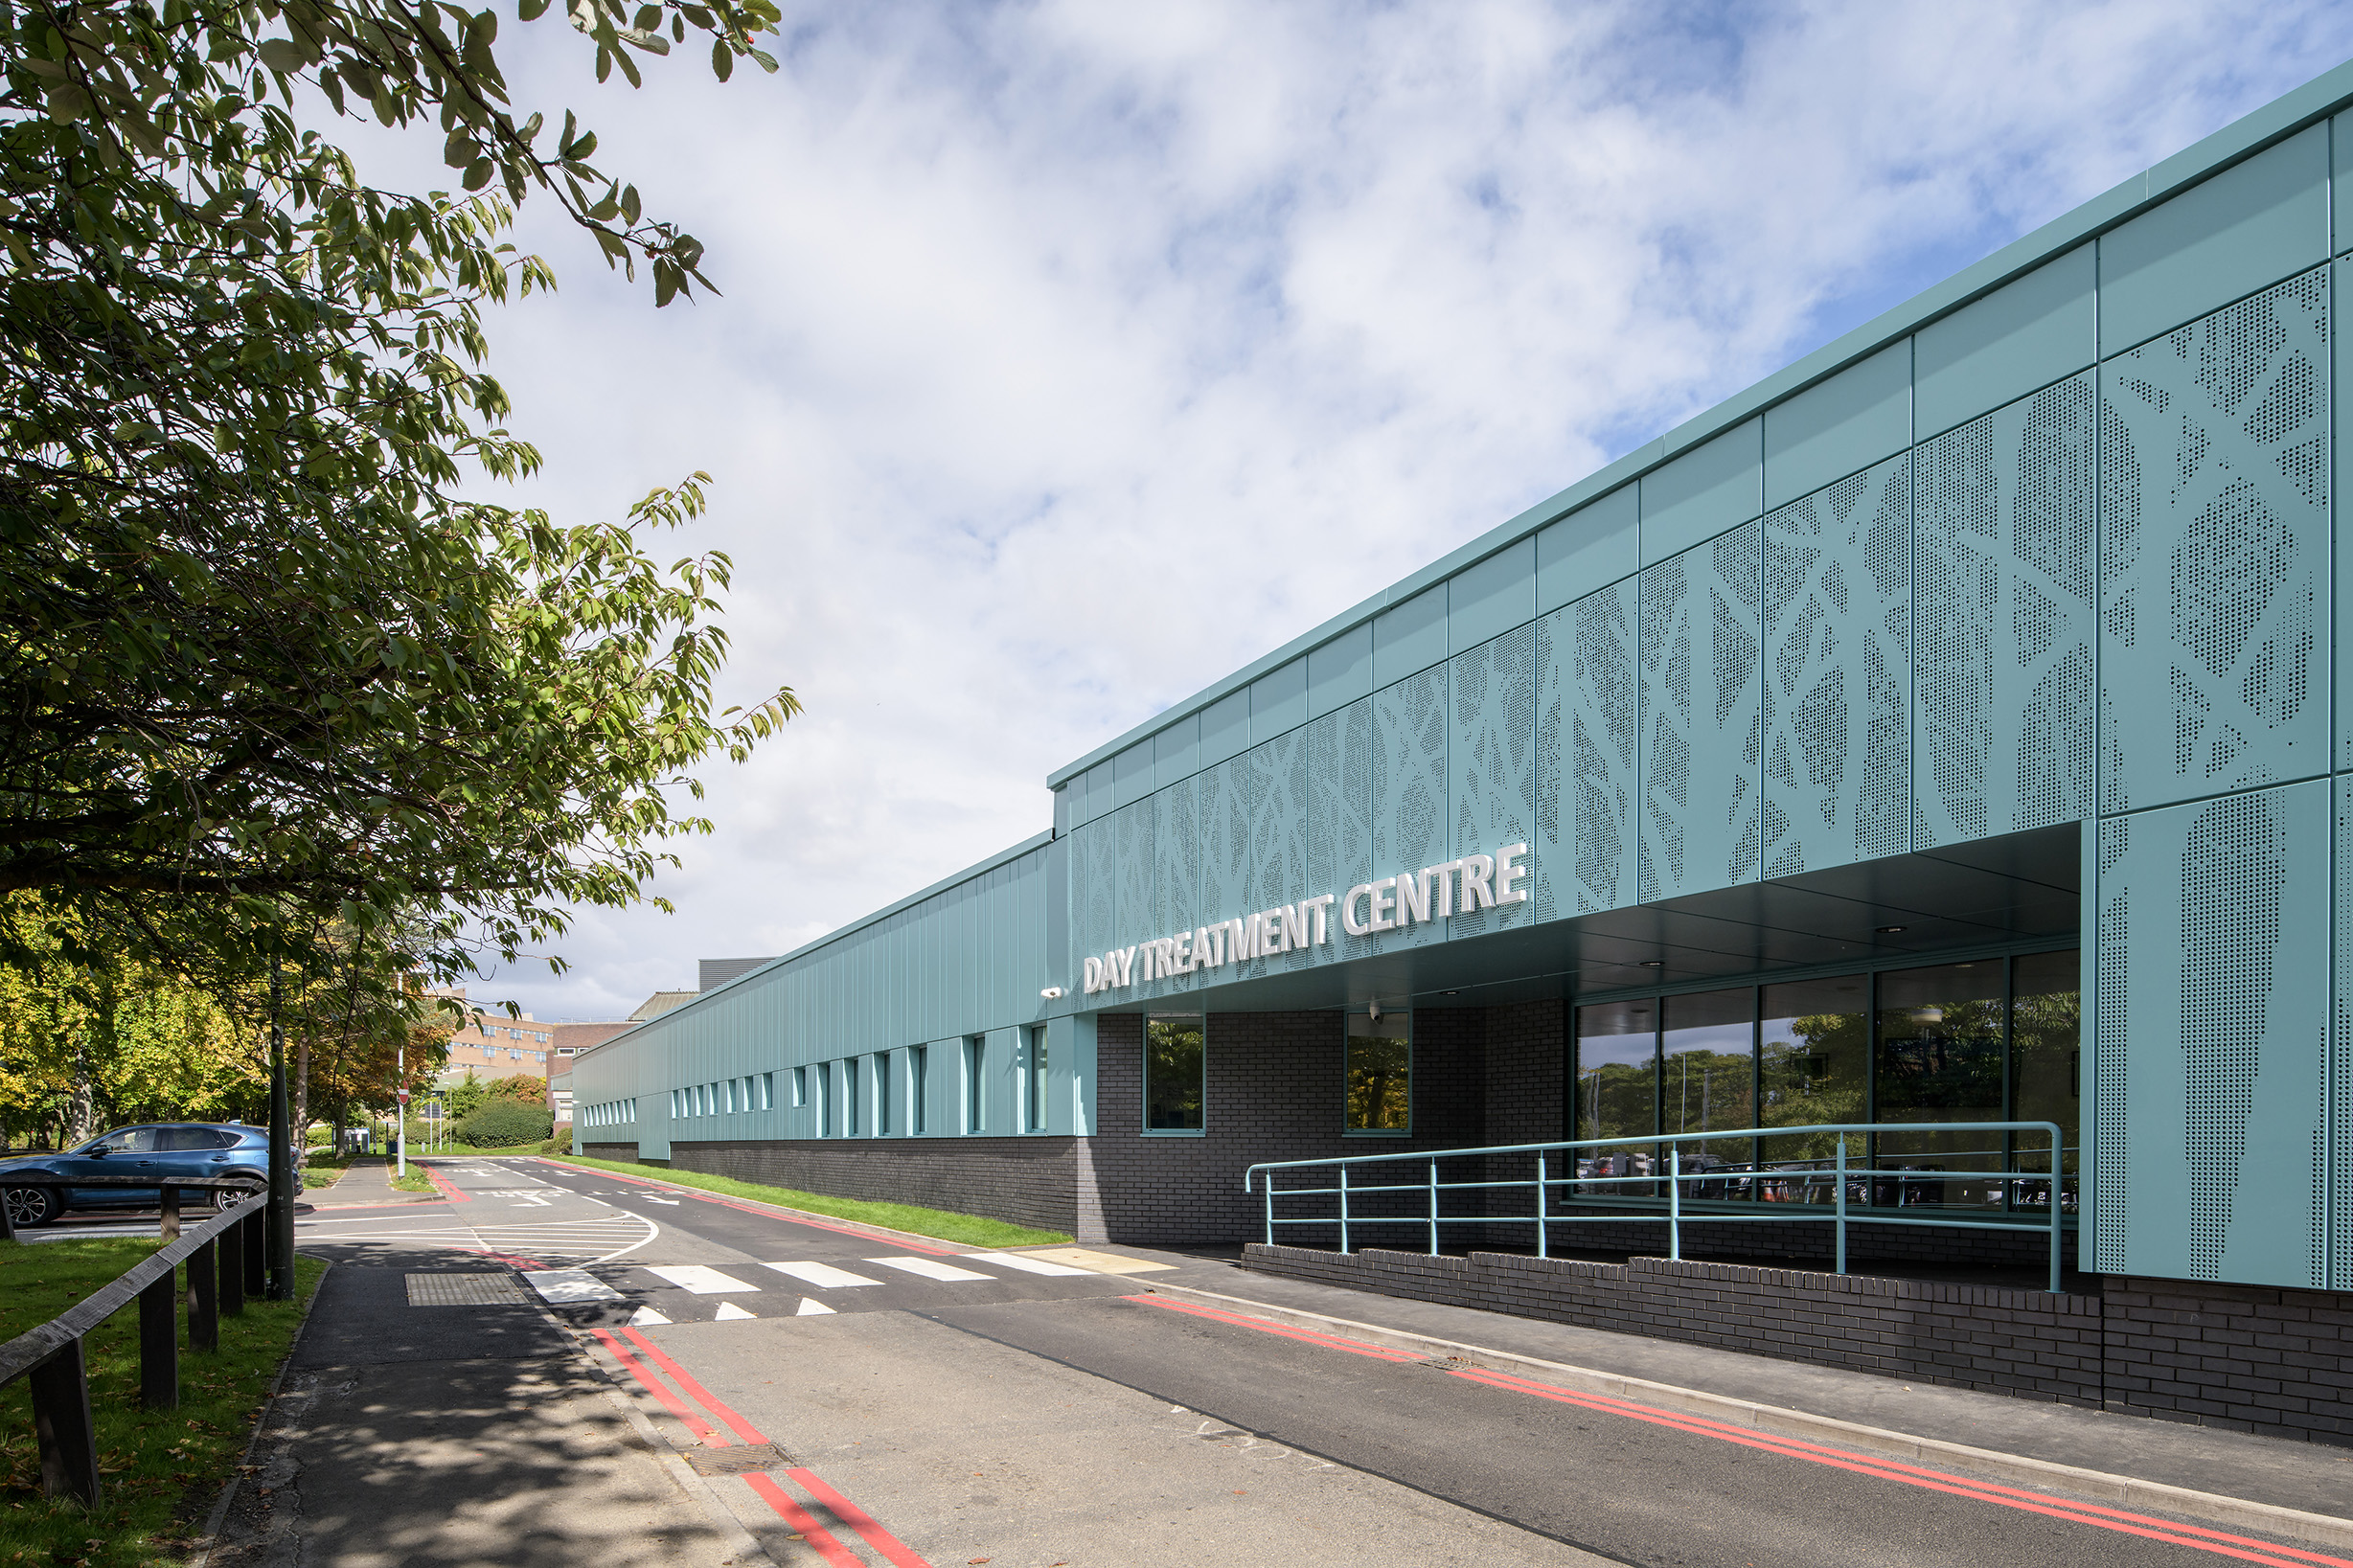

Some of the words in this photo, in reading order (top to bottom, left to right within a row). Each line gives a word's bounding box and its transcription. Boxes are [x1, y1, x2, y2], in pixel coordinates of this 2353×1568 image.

[1084, 945, 1136, 994] DAY
[1139, 894, 1335, 981] TREATMENT
[1342, 843, 1528, 936] CENTRE
